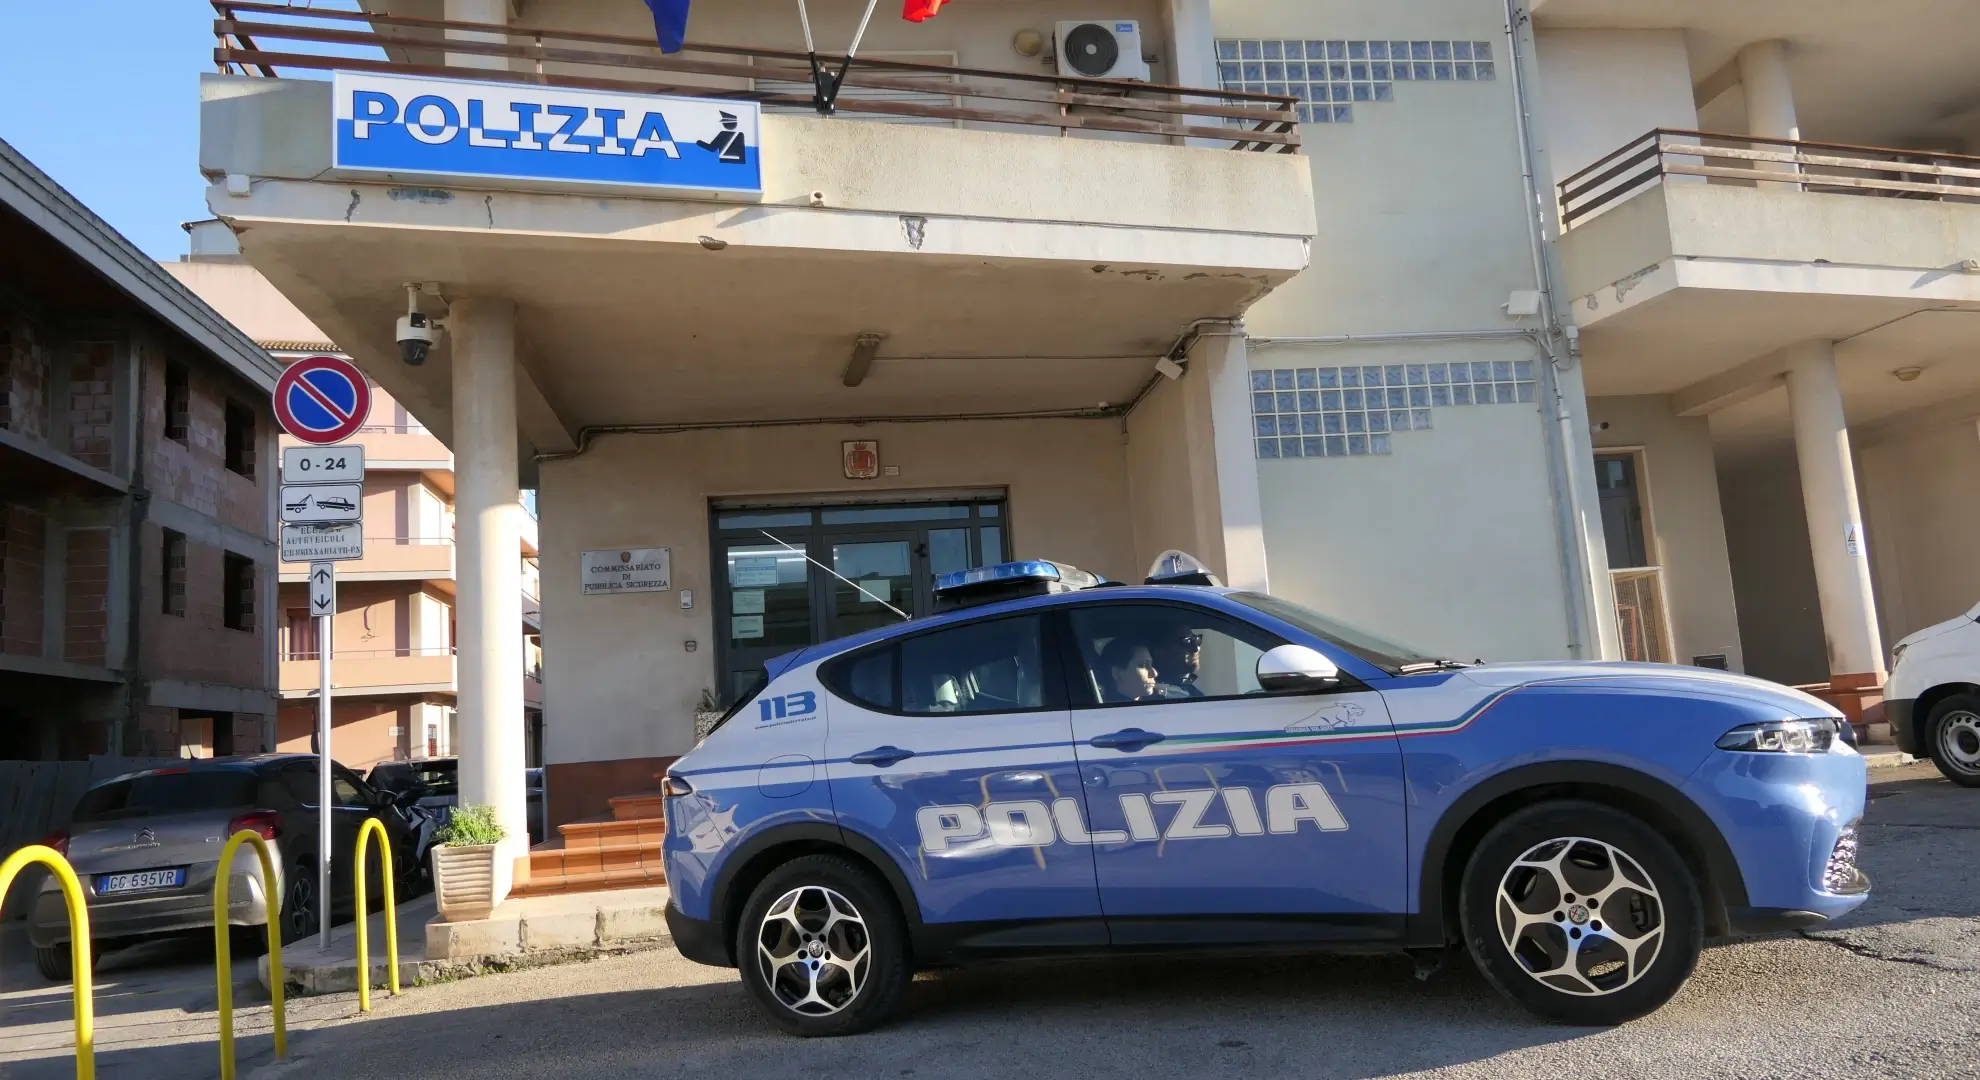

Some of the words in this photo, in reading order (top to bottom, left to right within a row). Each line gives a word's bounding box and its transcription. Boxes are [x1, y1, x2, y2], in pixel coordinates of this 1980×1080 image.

[352, 89, 682, 160] POLIZIA
[300, 458, 311, 471] 0
[325, 457, 347, 470] 24
[286, 534, 345, 545] AUTOVEICOLI
[590, 563, 661, 573] COMMISSARIATO
[622, 573, 631, 581] DI
[584, 582, 623, 591] PUBBLICA
[626, 580, 668, 589] SICUREZZA
[757, 690, 817, 722] 113
[915, 781, 1350, 853] POLIZIA
